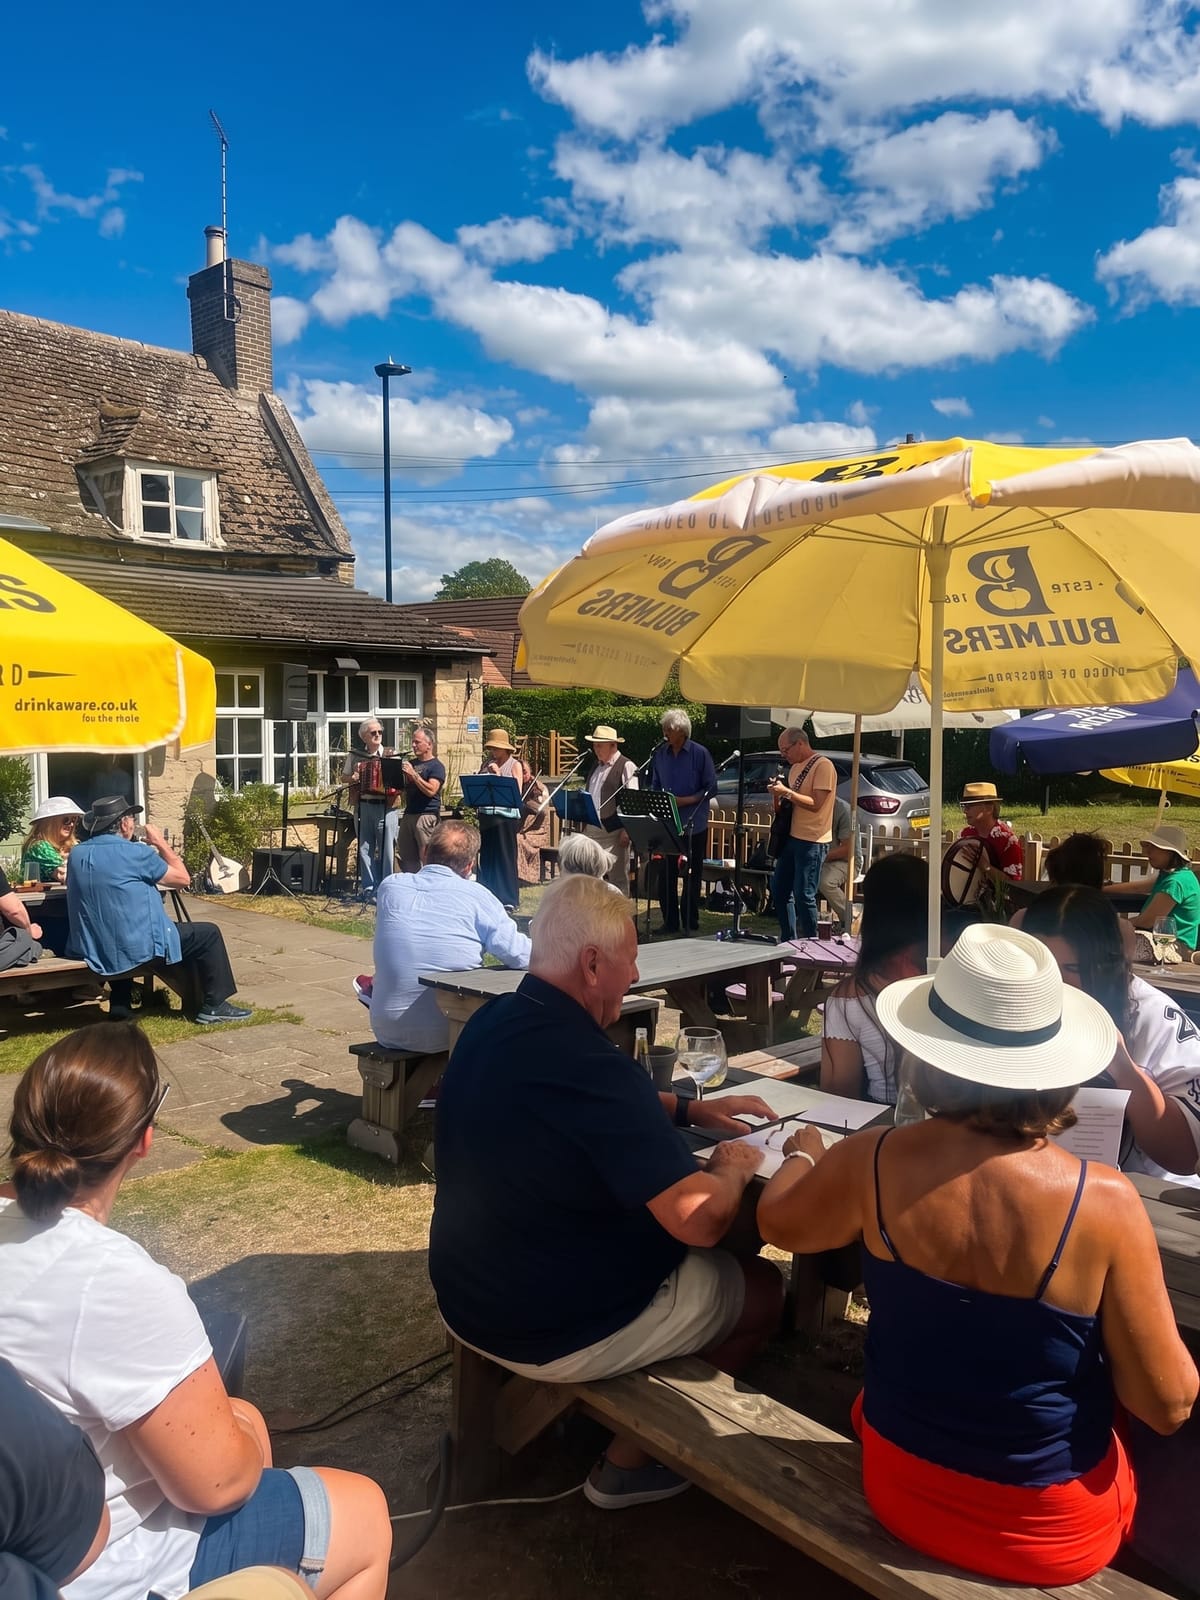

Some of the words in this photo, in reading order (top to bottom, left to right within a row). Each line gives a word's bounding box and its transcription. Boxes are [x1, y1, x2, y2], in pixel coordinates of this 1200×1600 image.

[0, 574, 57, 614] S
[14, 697, 138, 711] drinkaware.co.uk
[98, 713, 113, 723] the
